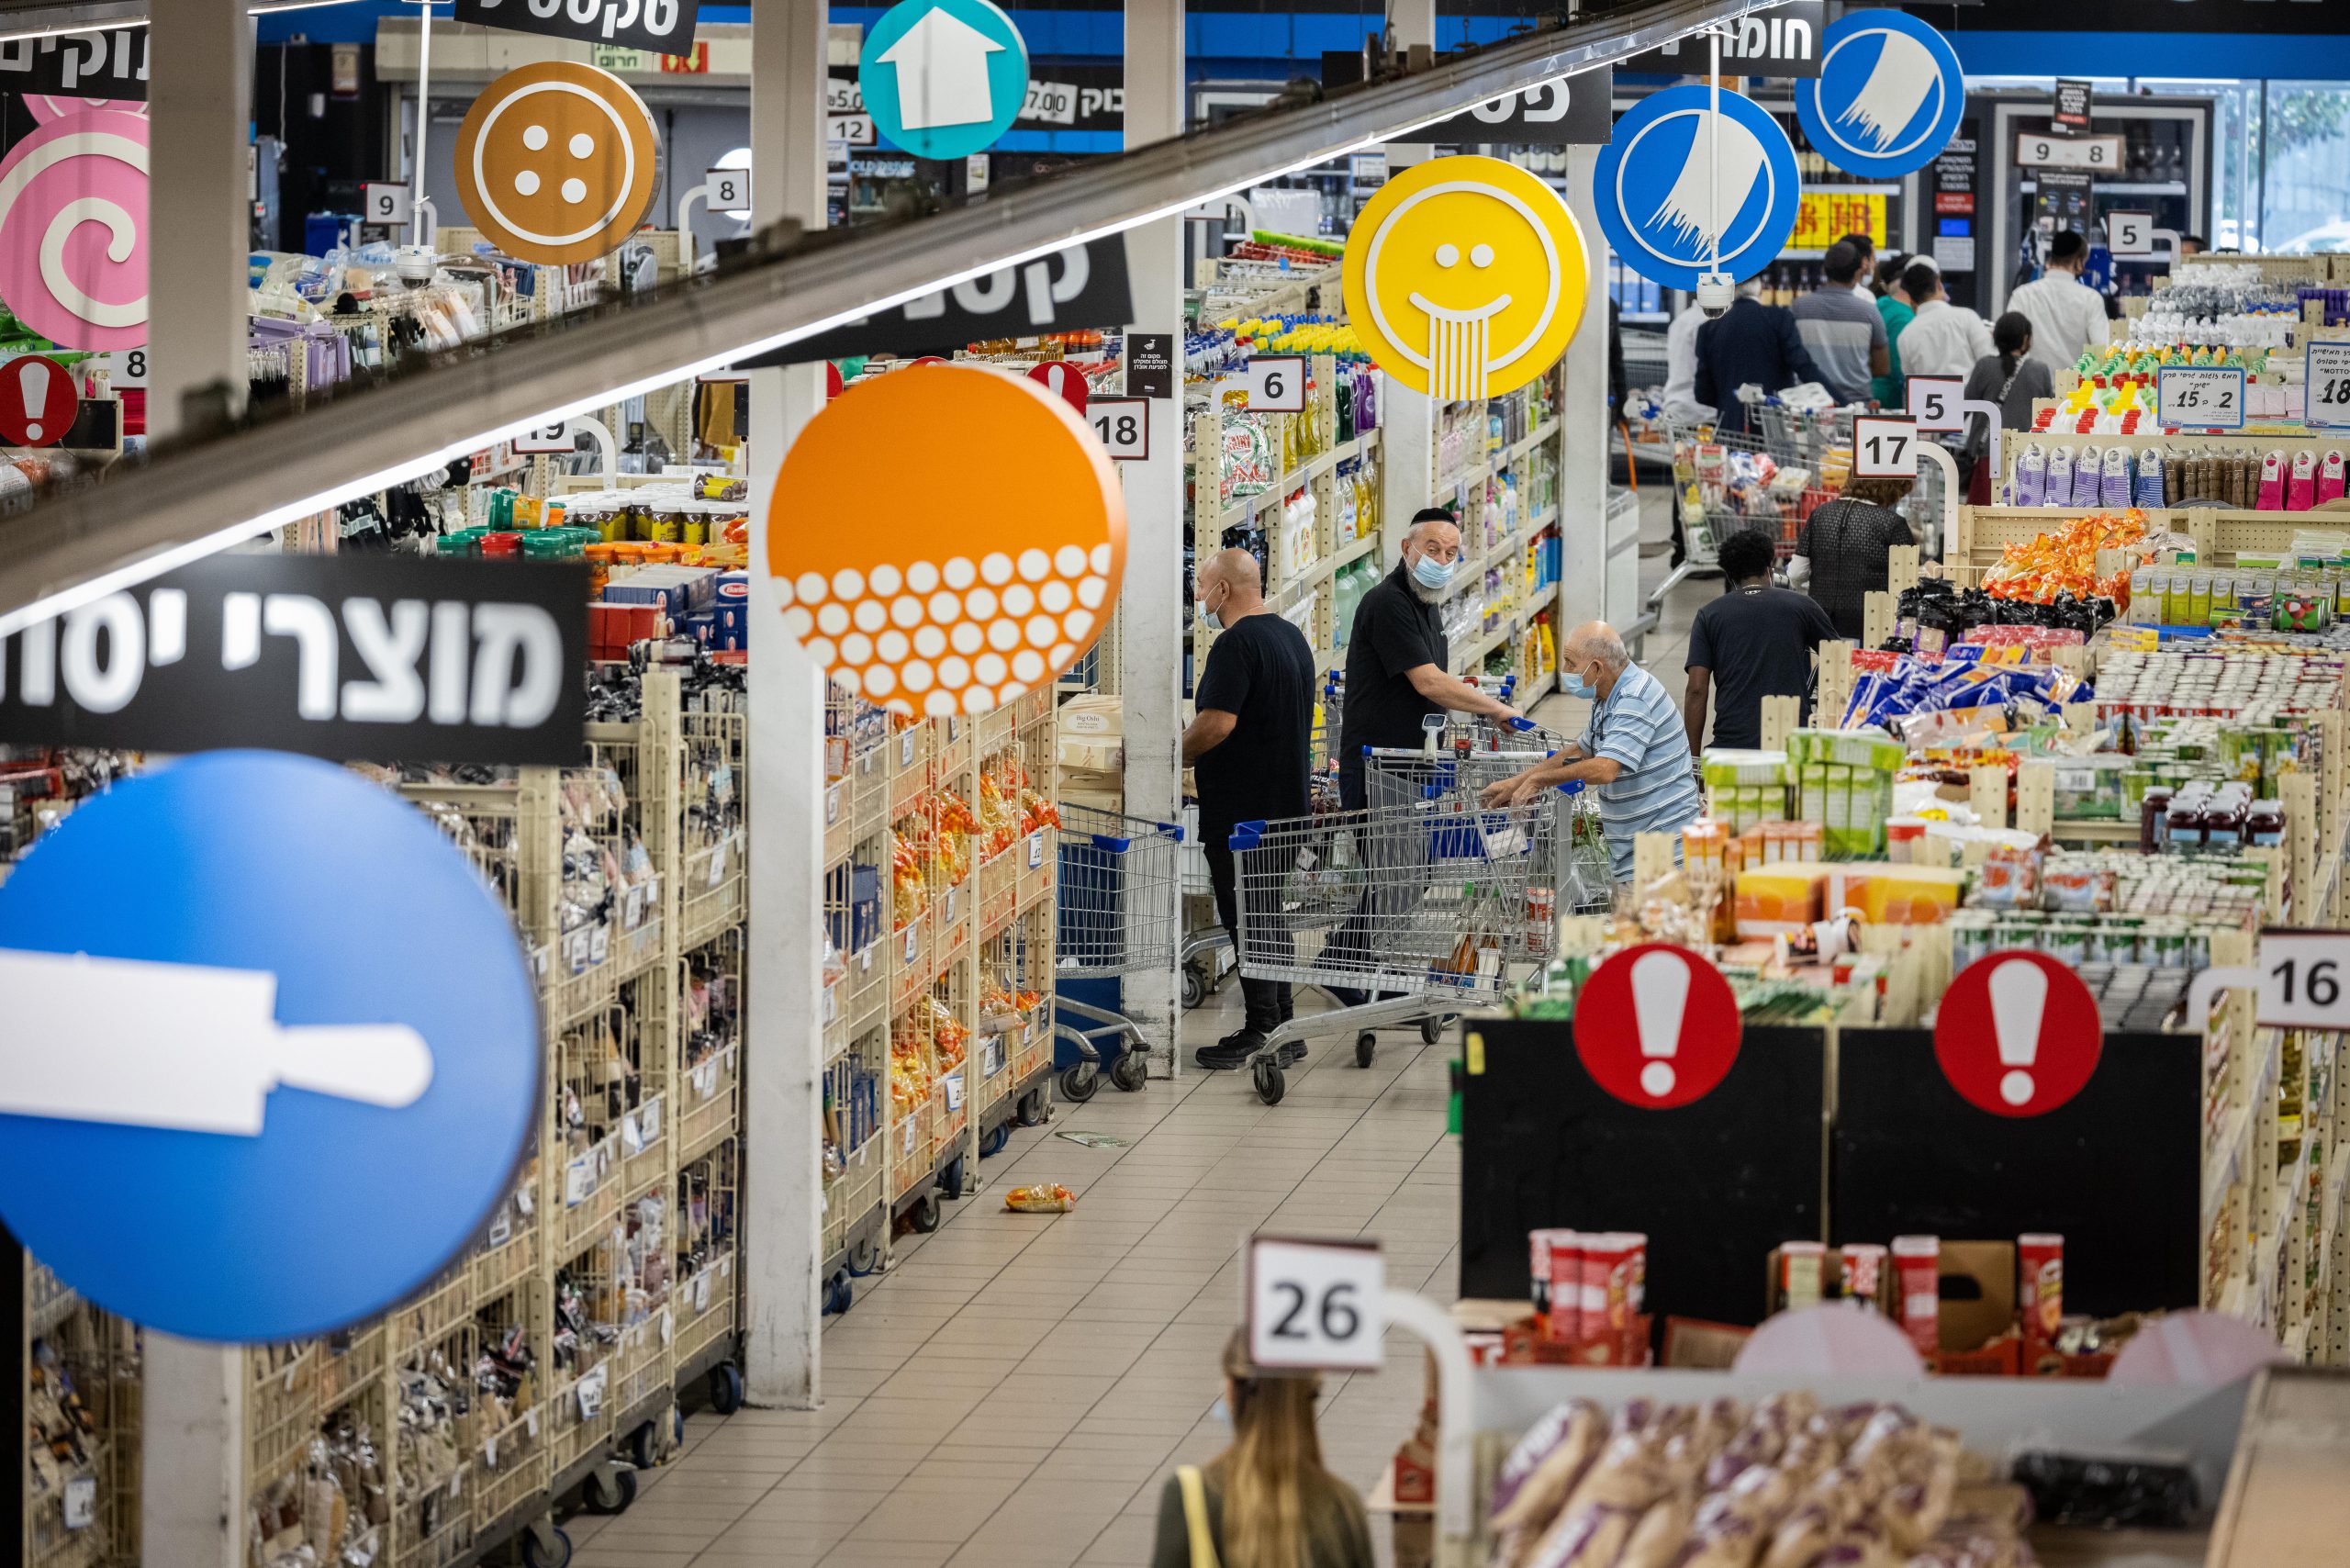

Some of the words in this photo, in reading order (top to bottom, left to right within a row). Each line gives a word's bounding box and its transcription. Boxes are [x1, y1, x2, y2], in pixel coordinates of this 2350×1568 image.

[836, 121, 863, 139] 12
[2036, 143, 2050, 161] 9
[2089, 146, 2103, 162] 8
[720, 181, 735, 201] 8
[379, 195, 394, 216] 9
[2122, 225, 2137, 245] 5
[127, 350, 147, 378] 8
[1264, 372, 1284, 399] 6
[1924, 394, 1944, 420] 5
[2177, 390, 2199, 408] 15
[2219, 391, 2233, 409] 2
[1094, 415, 1138, 445] 18
[1865, 436, 1908, 465] 17
[0, 589, 187, 713] יסו
[222, 592, 563, 727] מוצרי
[2271, 958, 2340, 1008] 16
[1271, 1282, 1360, 1341] 26
